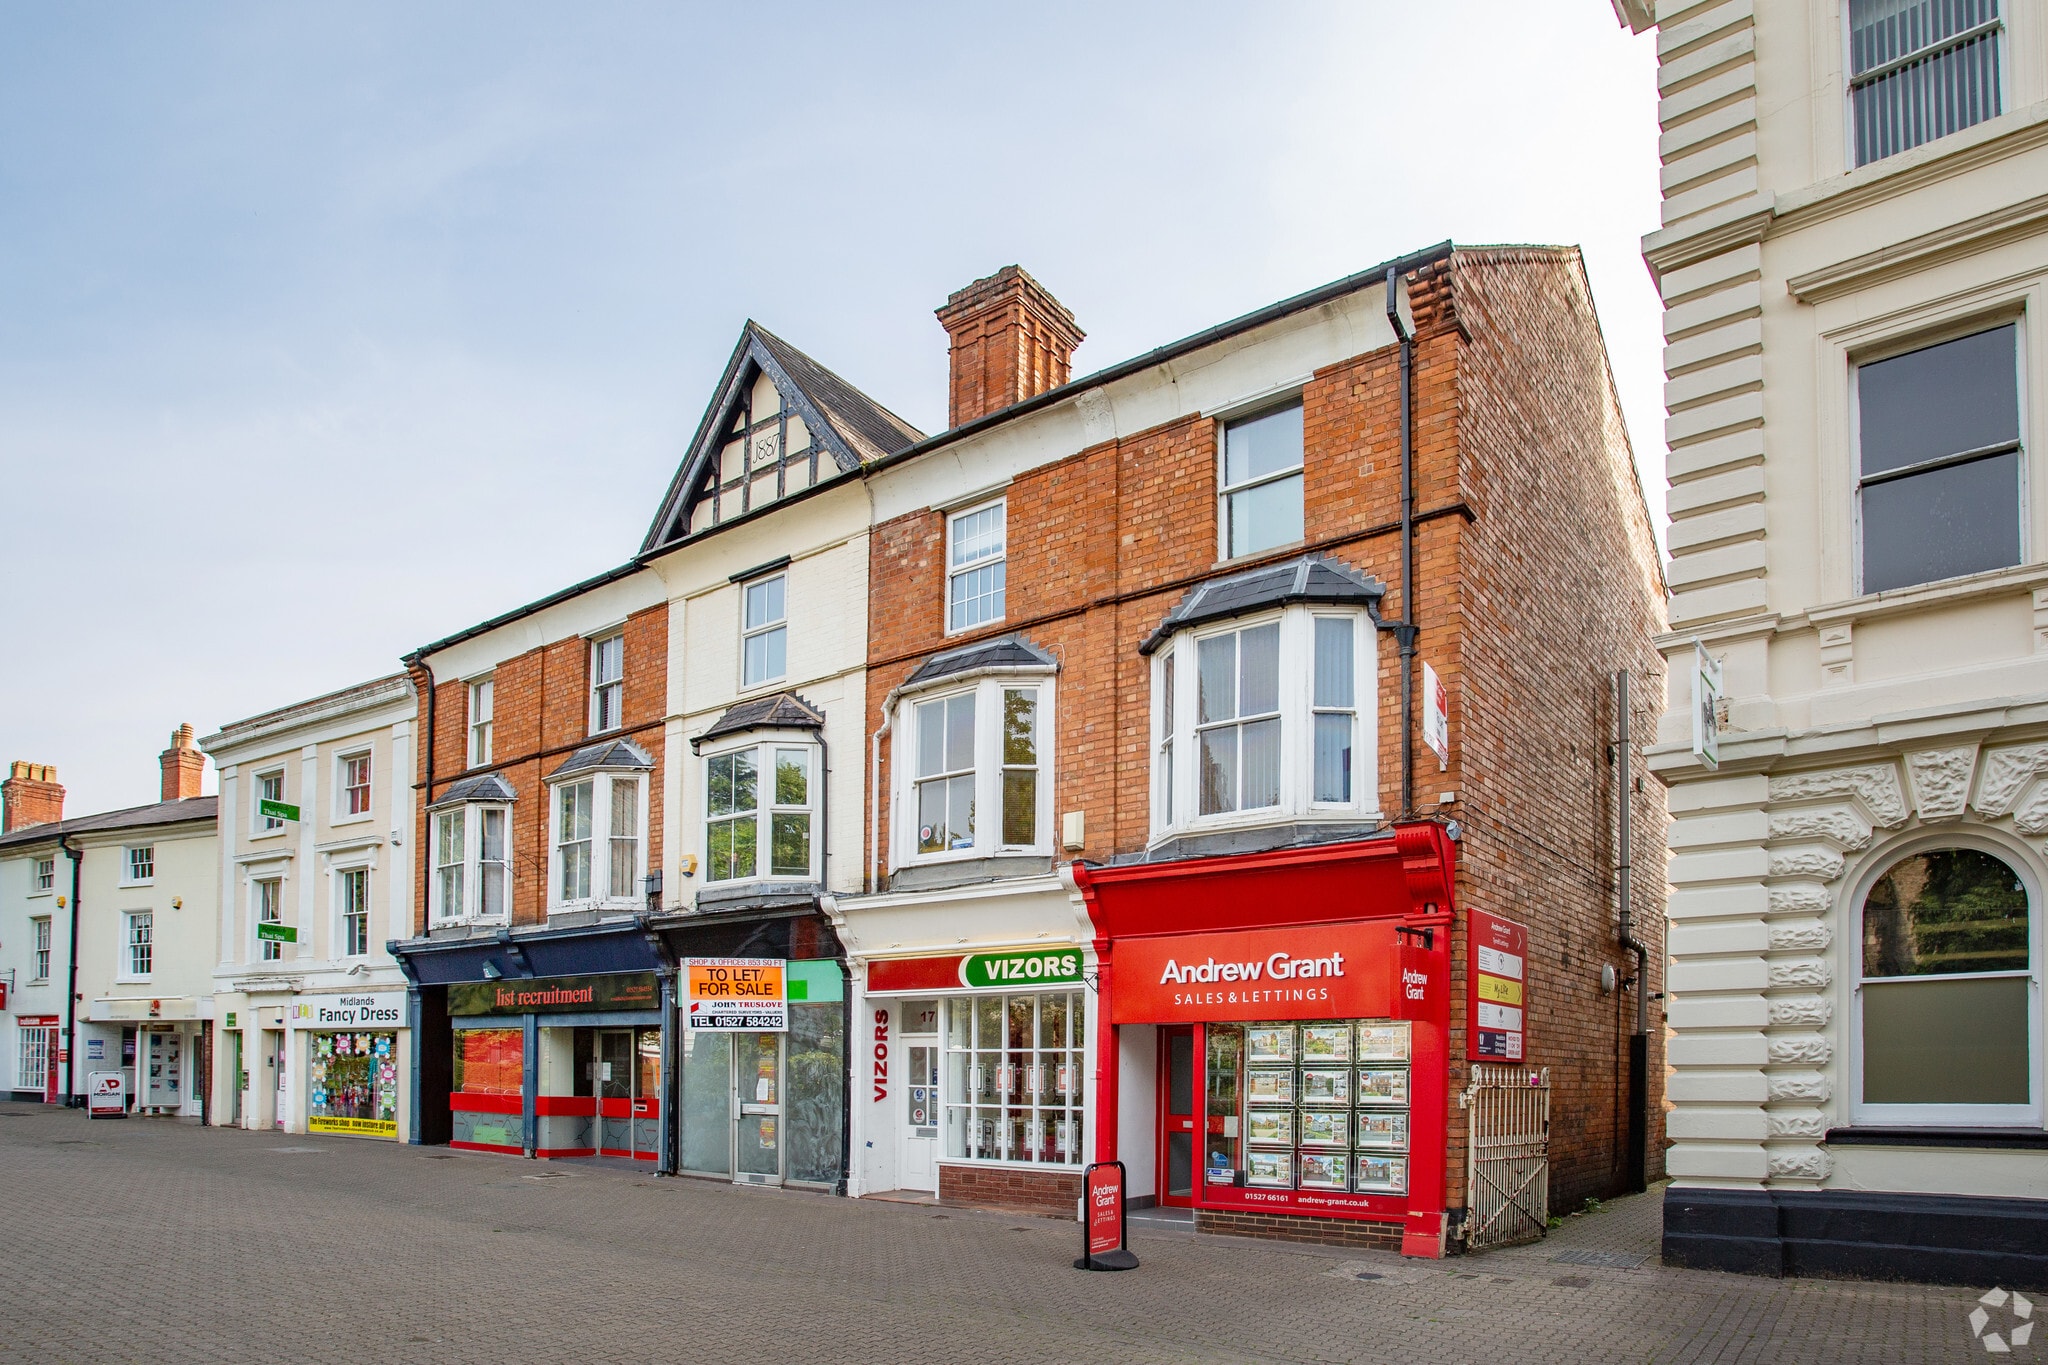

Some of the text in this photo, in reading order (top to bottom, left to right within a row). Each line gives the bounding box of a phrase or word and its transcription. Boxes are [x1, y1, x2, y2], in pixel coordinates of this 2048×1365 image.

[753, 433, 780, 464] 1887
[706, 968, 727, 981] TO
[985, 955, 1076, 980] VIZORS
[1160, 952, 1344, 985] Andrew Grant
[1402, 967, 1428, 985] Andrew
[495, 985, 593, 1007] list recruitment
[699, 983, 773, 996] FOR SALE
[1406, 983, 1424, 1000] Grant
[340, 997, 375, 1006] Midlands
[320, 1007, 398, 1024] Fancy Dress
[692, 1016, 782, 1027] TEL 01527 584242
[920, 1011, 935, 1023] 17
[874, 1009, 889, 1103] VIZORS
[1092, 1184, 1118, 1197] Andrew
[1096, 1194, 1115, 1207] Grant
[1245, 1192, 1369, 1207] 01527 66161 andrew-grant.co.uk
